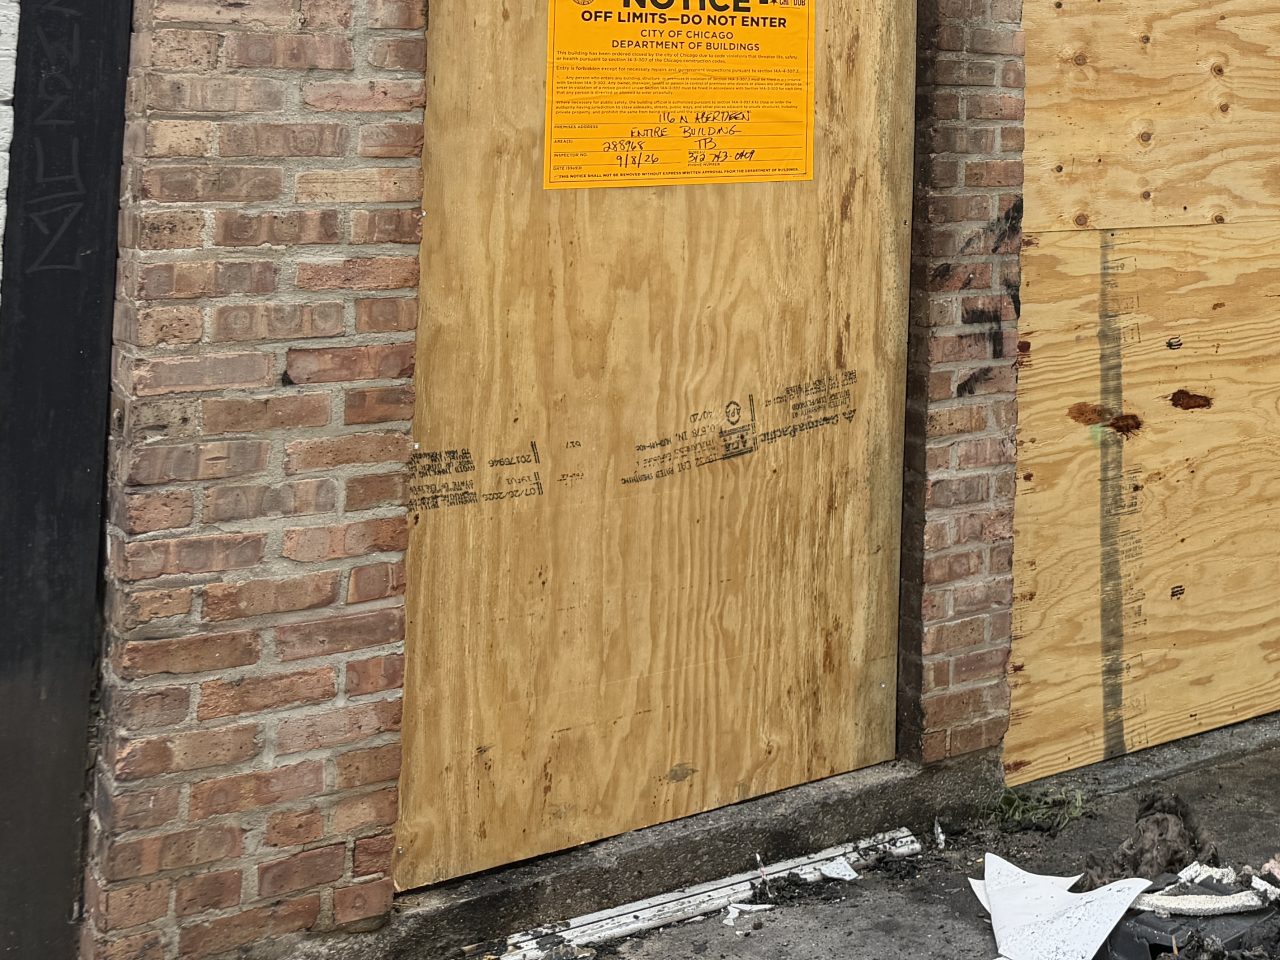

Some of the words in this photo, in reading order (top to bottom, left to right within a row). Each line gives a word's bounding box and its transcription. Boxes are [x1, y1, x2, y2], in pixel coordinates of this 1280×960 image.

[580, 9, 612, 22] OFF
[706, 14, 736, 26] NOT
[741, 15, 787, 28] ENTER
[640, 28, 665, 38] CITY
[667, 29, 682, 39] OF
[685, 30, 734, 40] CHICAGO
[611, 39, 685, 50] DEPARTMENT
[688, 41, 703, 50] OF
[705, 41, 760, 51] BUILDINGS
[630, 126, 669, 138] ENTIRE
